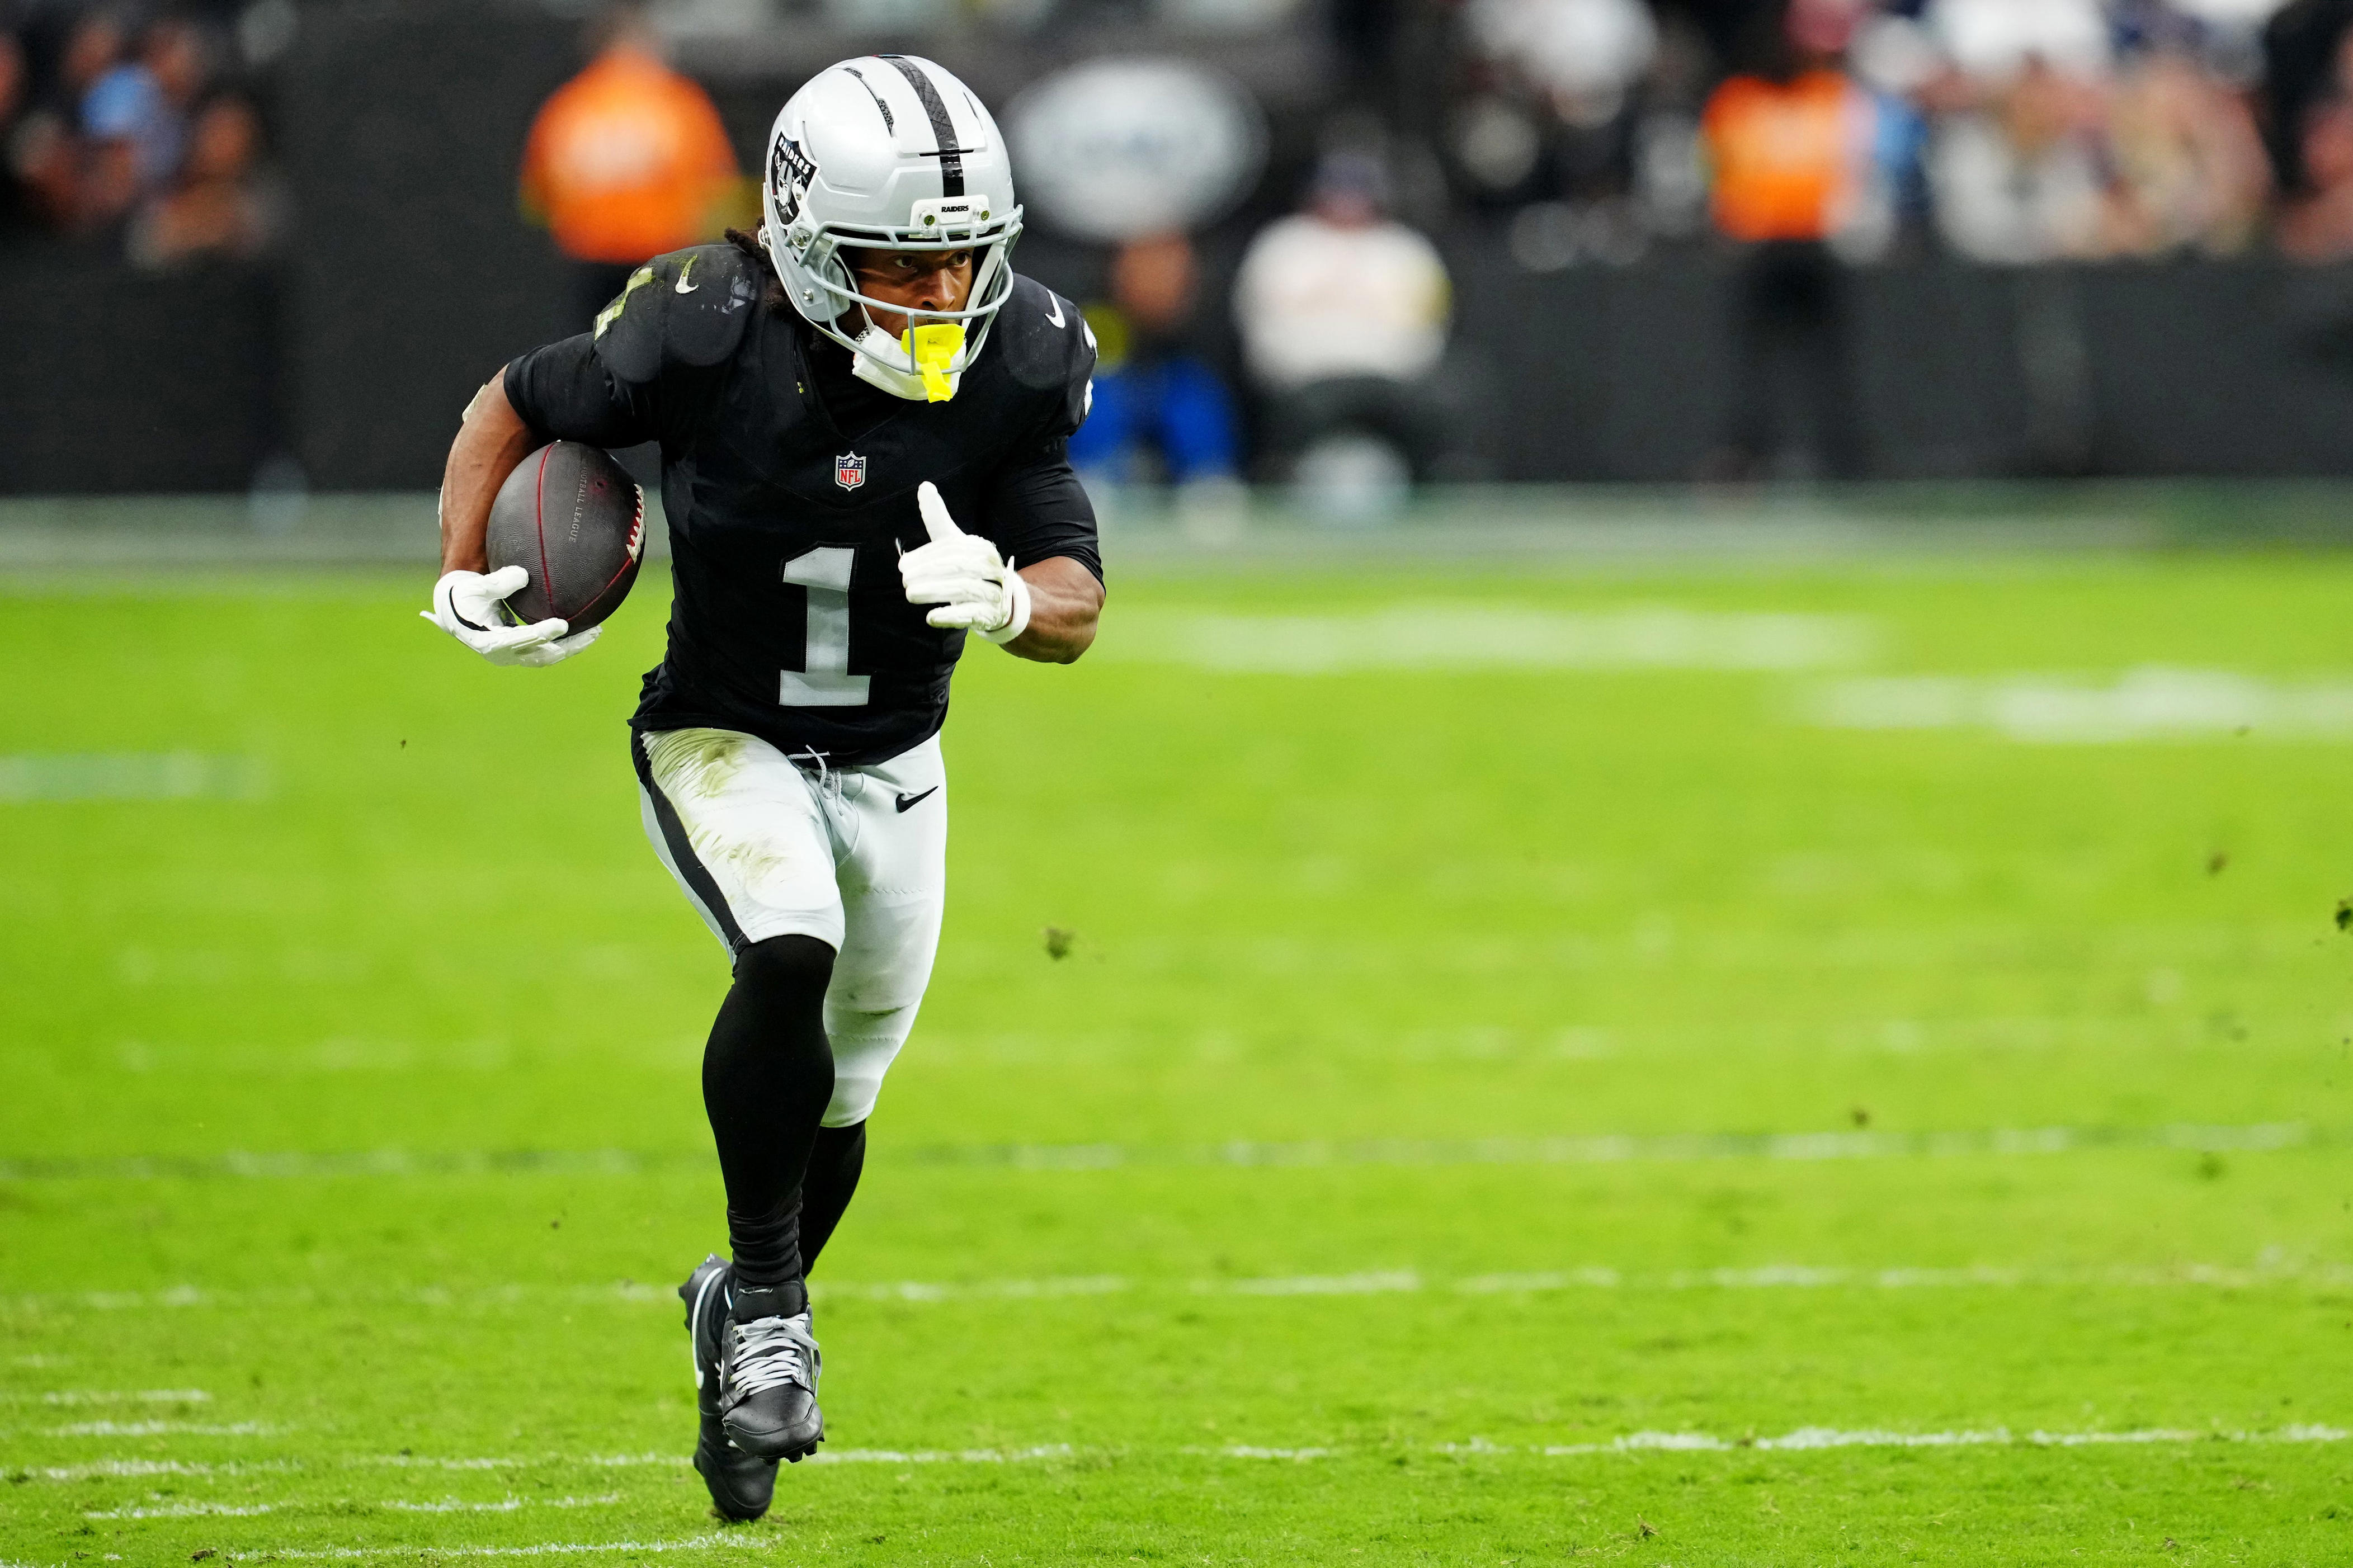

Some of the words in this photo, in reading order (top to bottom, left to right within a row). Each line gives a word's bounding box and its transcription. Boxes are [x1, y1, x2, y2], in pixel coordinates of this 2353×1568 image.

[778, 136, 811, 175] RAIDERS
[840, 470, 860, 484] NFL
[569, 507, 582, 542] LEAGUE
[779, 547, 871, 706] 1
